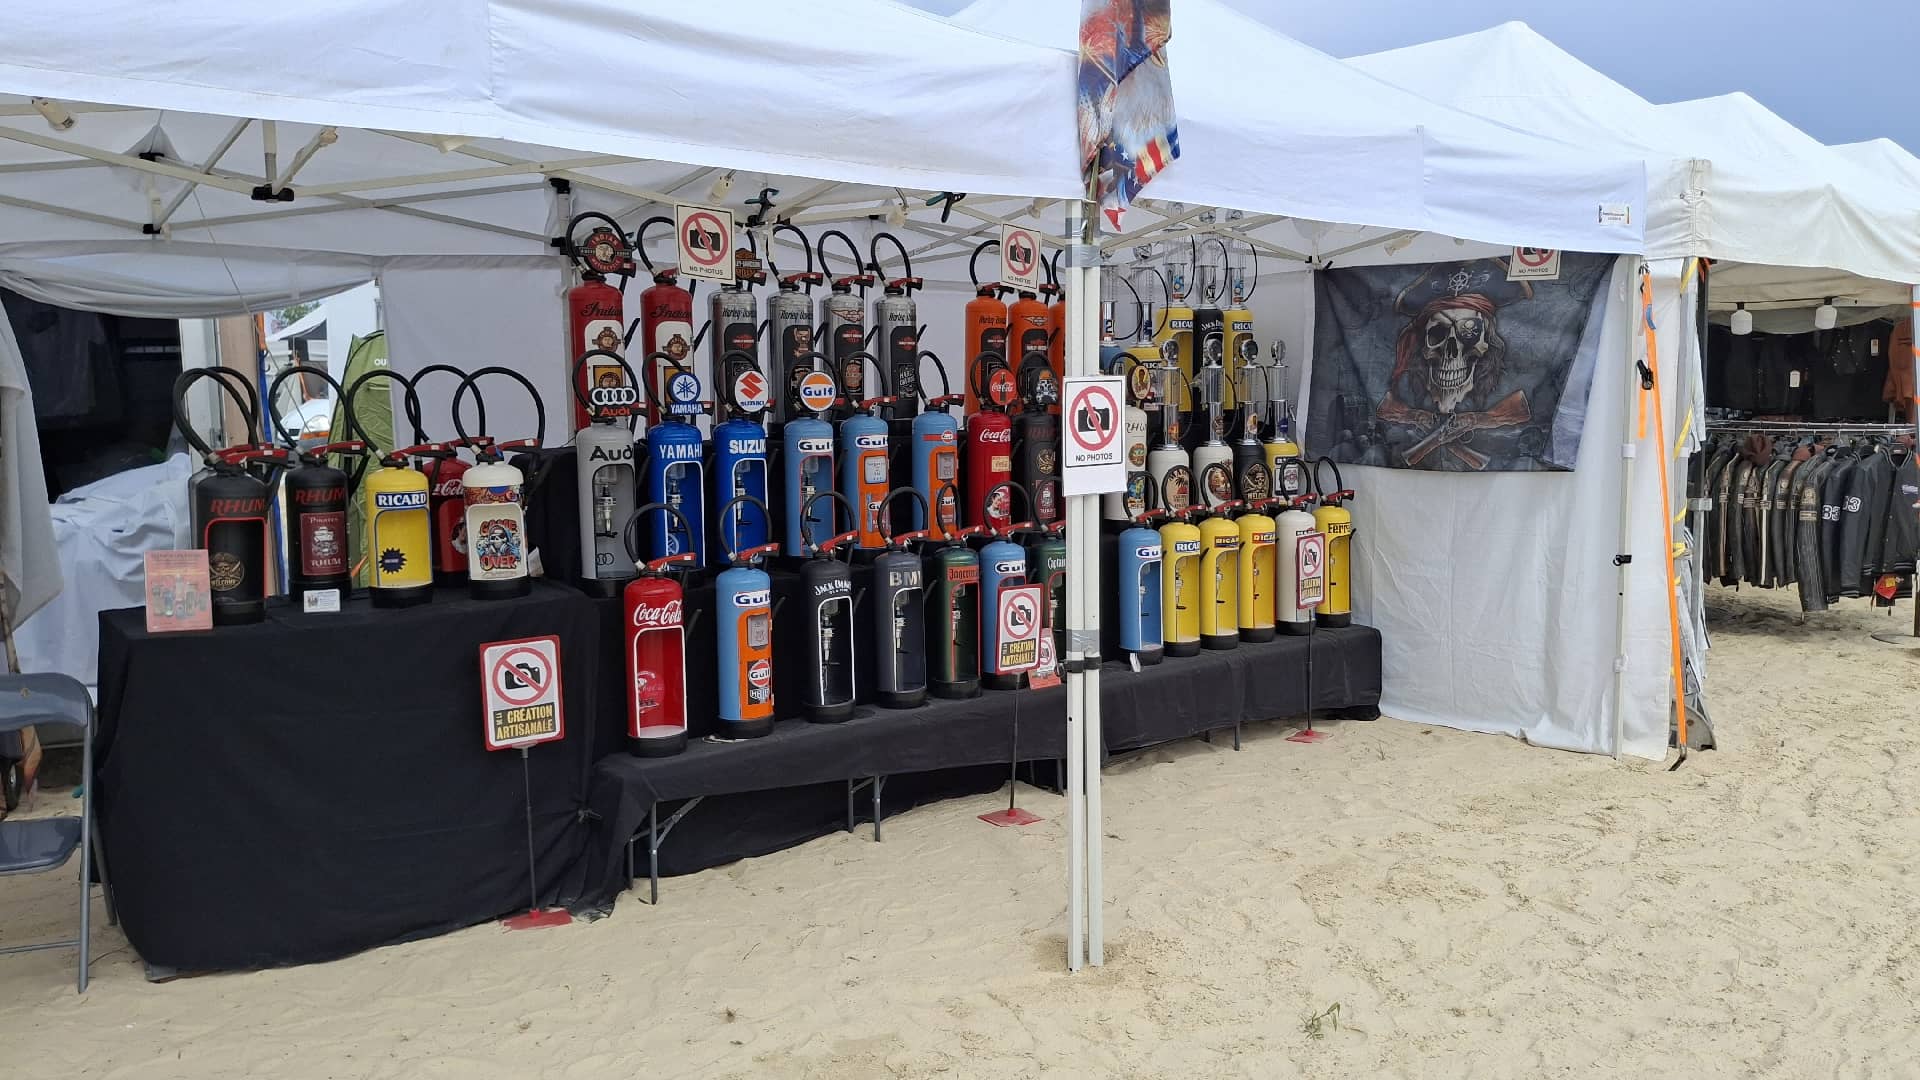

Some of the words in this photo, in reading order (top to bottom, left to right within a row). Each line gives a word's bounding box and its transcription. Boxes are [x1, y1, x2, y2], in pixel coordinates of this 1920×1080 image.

[803, 385, 835, 397] Gulf
[600, 407, 631, 417] Audi
[670, 404, 704, 416] YAMAHA
[1075, 454, 1086, 463] NO
[1086, 452, 1113, 462] PHOTOS
[378, 493, 427, 507] RICARD
[480, 518, 518, 537] GAME
[310, 557, 342, 569] RHUM
[479, 555, 518, 571] OVER
[507, 704, 553, 724] CRÉATION
[496, 718, 553, 740] ARTISANALE
